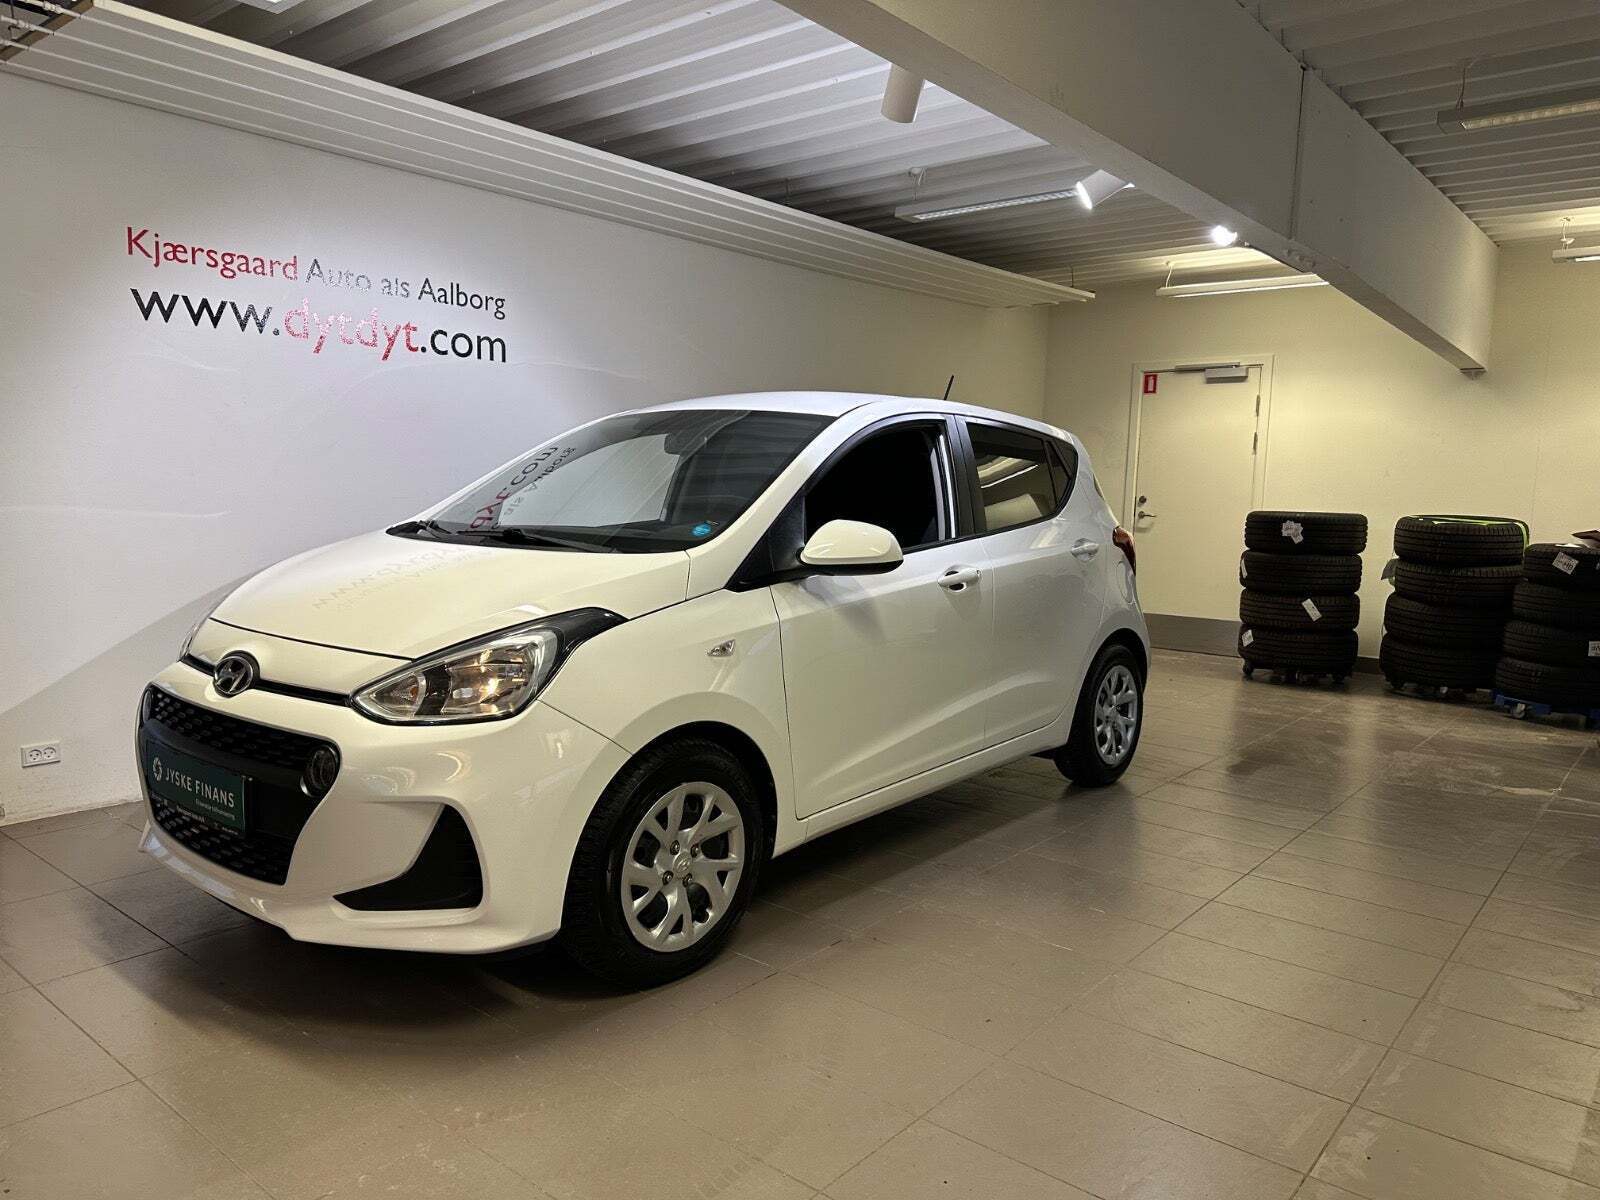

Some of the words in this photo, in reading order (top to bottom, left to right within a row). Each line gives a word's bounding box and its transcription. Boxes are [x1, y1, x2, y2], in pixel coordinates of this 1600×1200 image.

[127, 226, 298, 280] Kjærsgaard
[306, 258, 373, 292] Auto
[381, 277, 410, 299] als
[418, 277, 506, 321] Aalborg
[130, 287, 507, 364] www.dytdyt.com
[165, 767, 193, 792] JYSKE
[195, 780, 235, 809] FINANS
